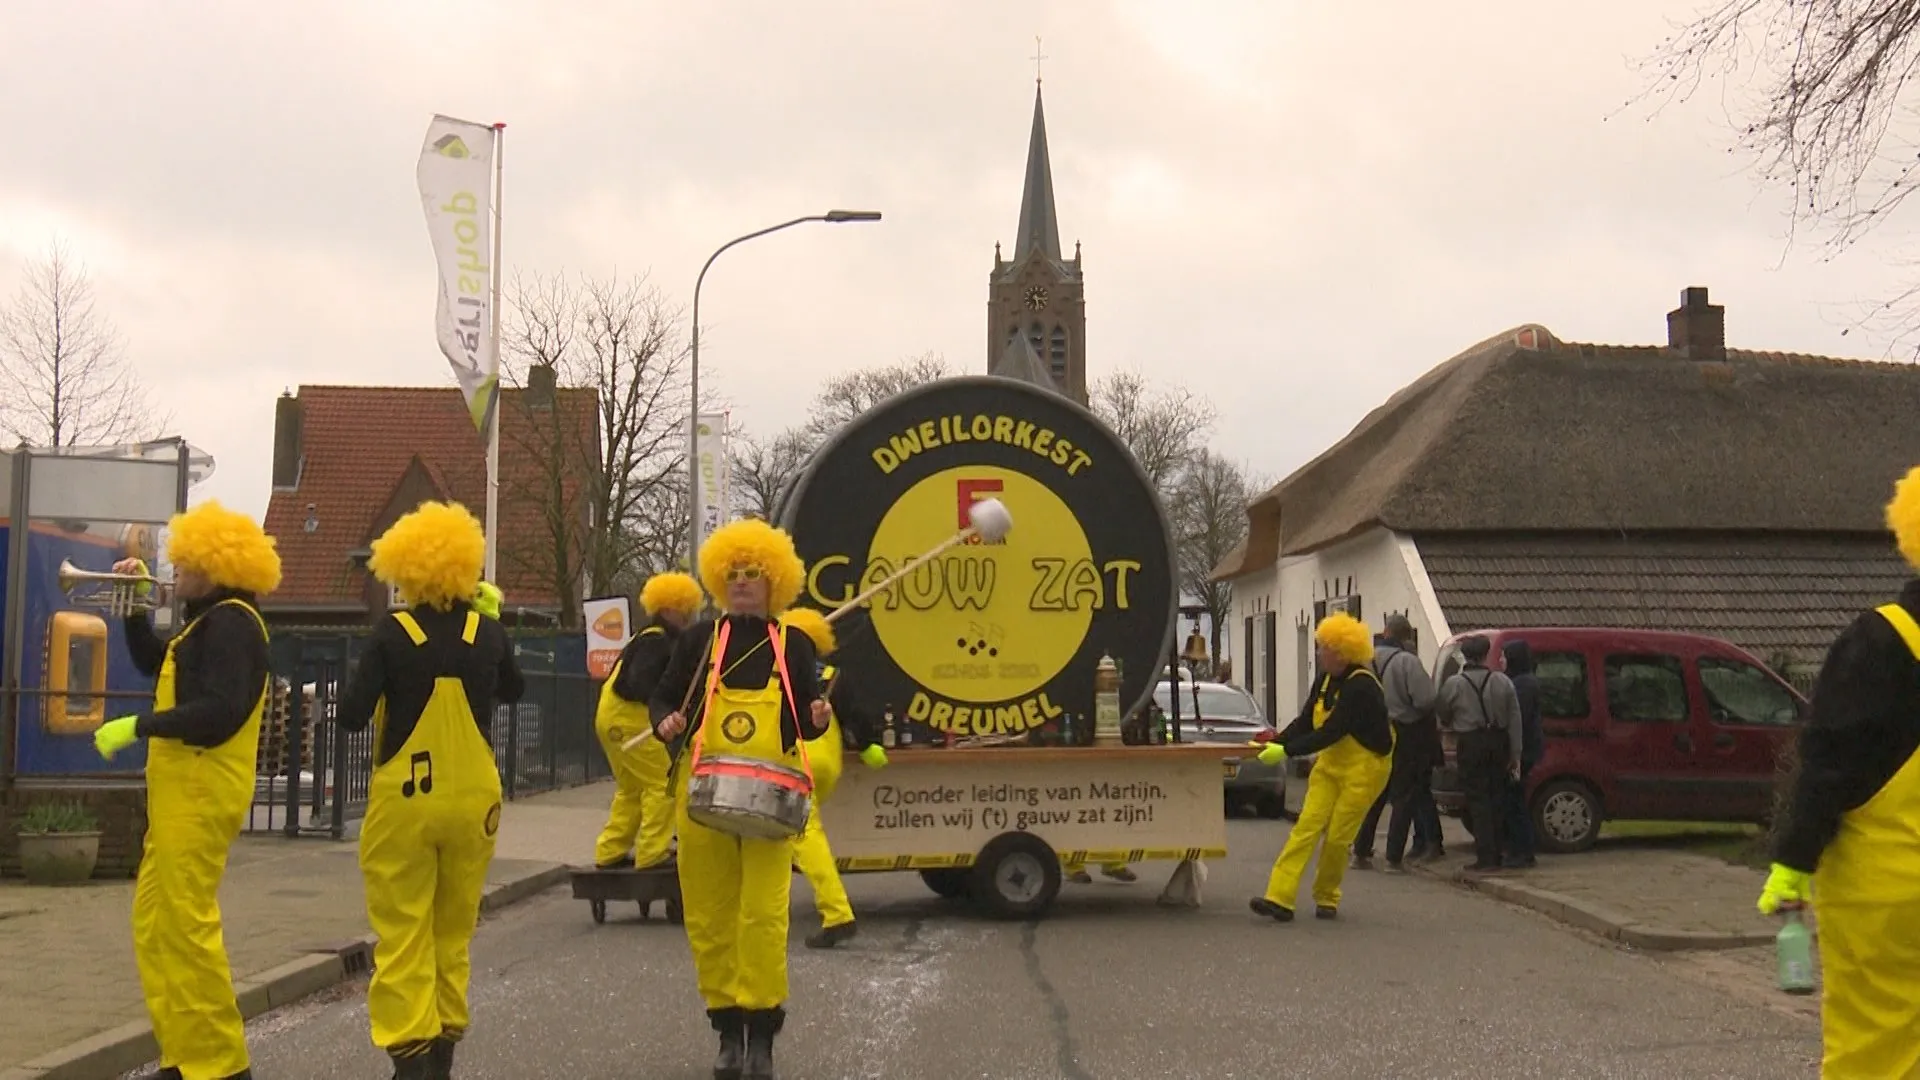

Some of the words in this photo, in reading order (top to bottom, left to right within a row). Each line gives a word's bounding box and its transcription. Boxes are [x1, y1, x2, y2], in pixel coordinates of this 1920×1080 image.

[871, 414, 1093, 477] DWEILORKEST
[807, 554, 997, 611] GAUW
[1028, 557, 1142, 611] ZAT
[907, 691, 1063, 737] DREUMEL
[873, 784, 964, 808] (Z)onder
[971, 783, 1039, 806] leiding
[1045, 786, 1082, 800] van
[874, 808, 936, 829] zullen
[942, 807, 974, 831] wij
[1016, 809, 1071, 831] gauw
[1077, 807, 1107, 824] zat
[1113, 804, 1154, 826] zijn!
